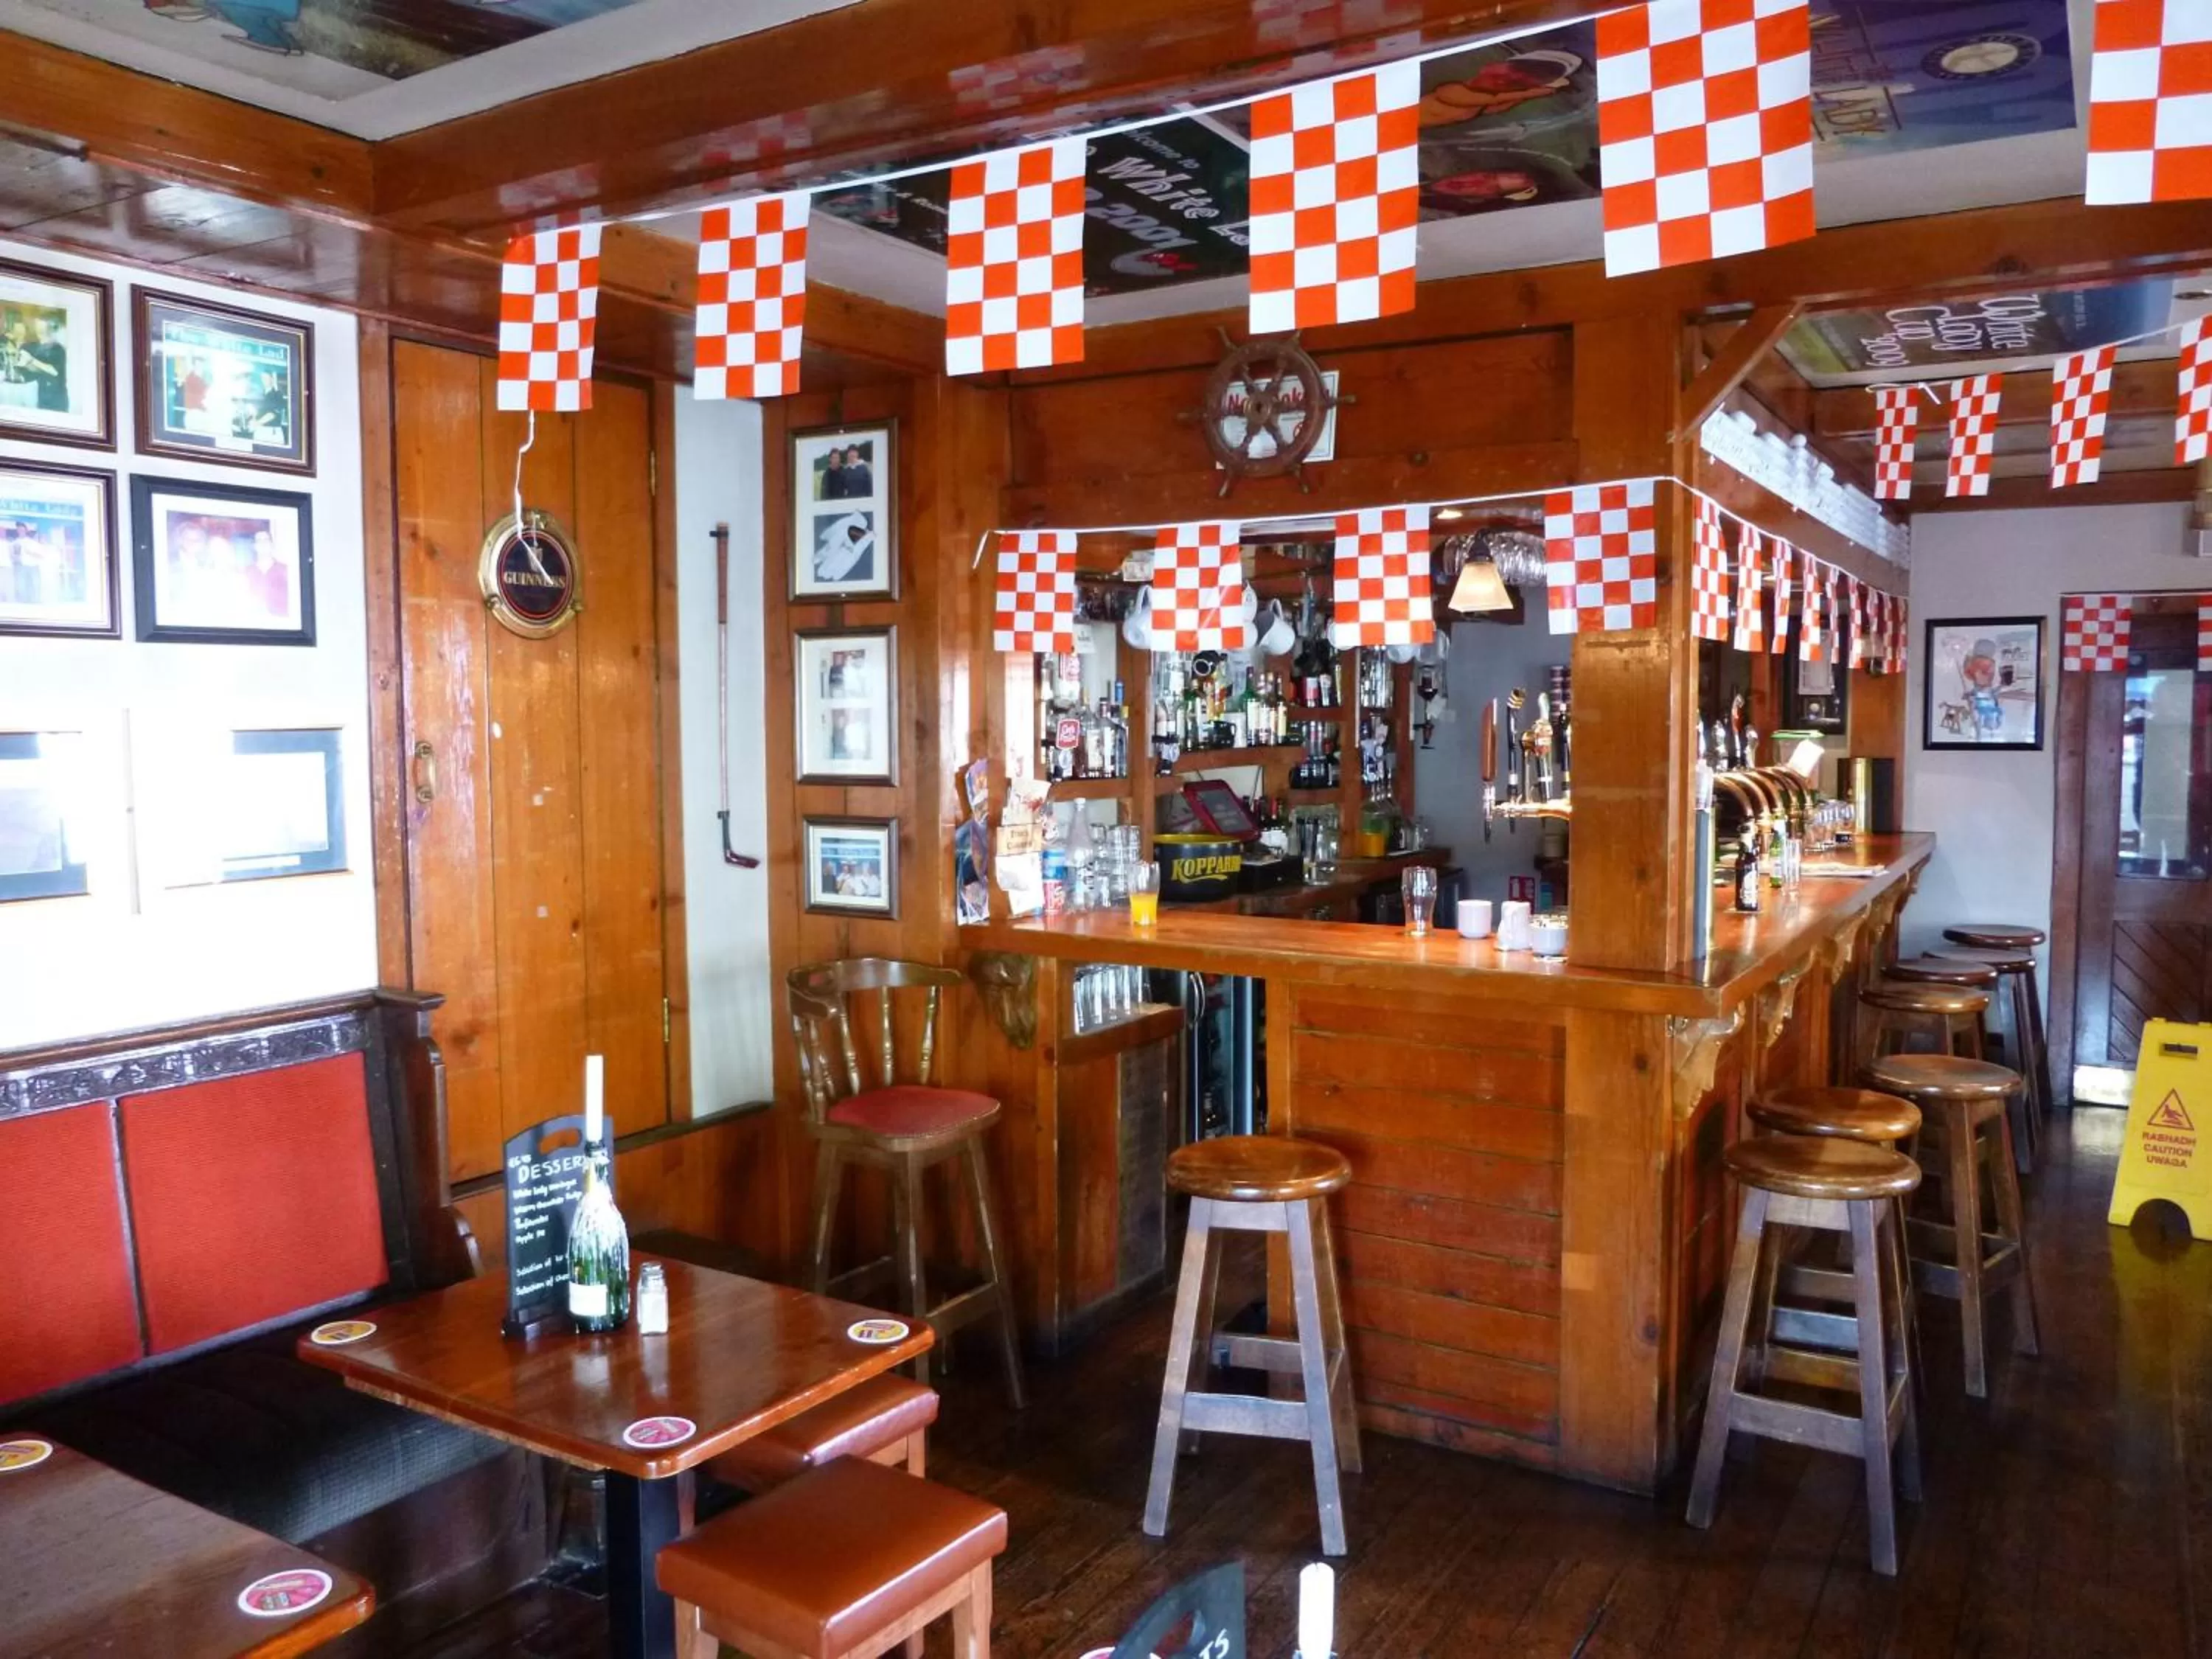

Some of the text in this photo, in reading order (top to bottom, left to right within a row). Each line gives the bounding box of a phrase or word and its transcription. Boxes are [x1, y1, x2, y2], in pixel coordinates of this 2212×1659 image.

[1097, 157, 1250, 246] White La
[1885, 306, 1951, 341] Cup
[1931, 313, 1985, 351] Lady
[1979, 294, 2046, 349] White
[2143, 1144, 2192, 1158] CAUTION
